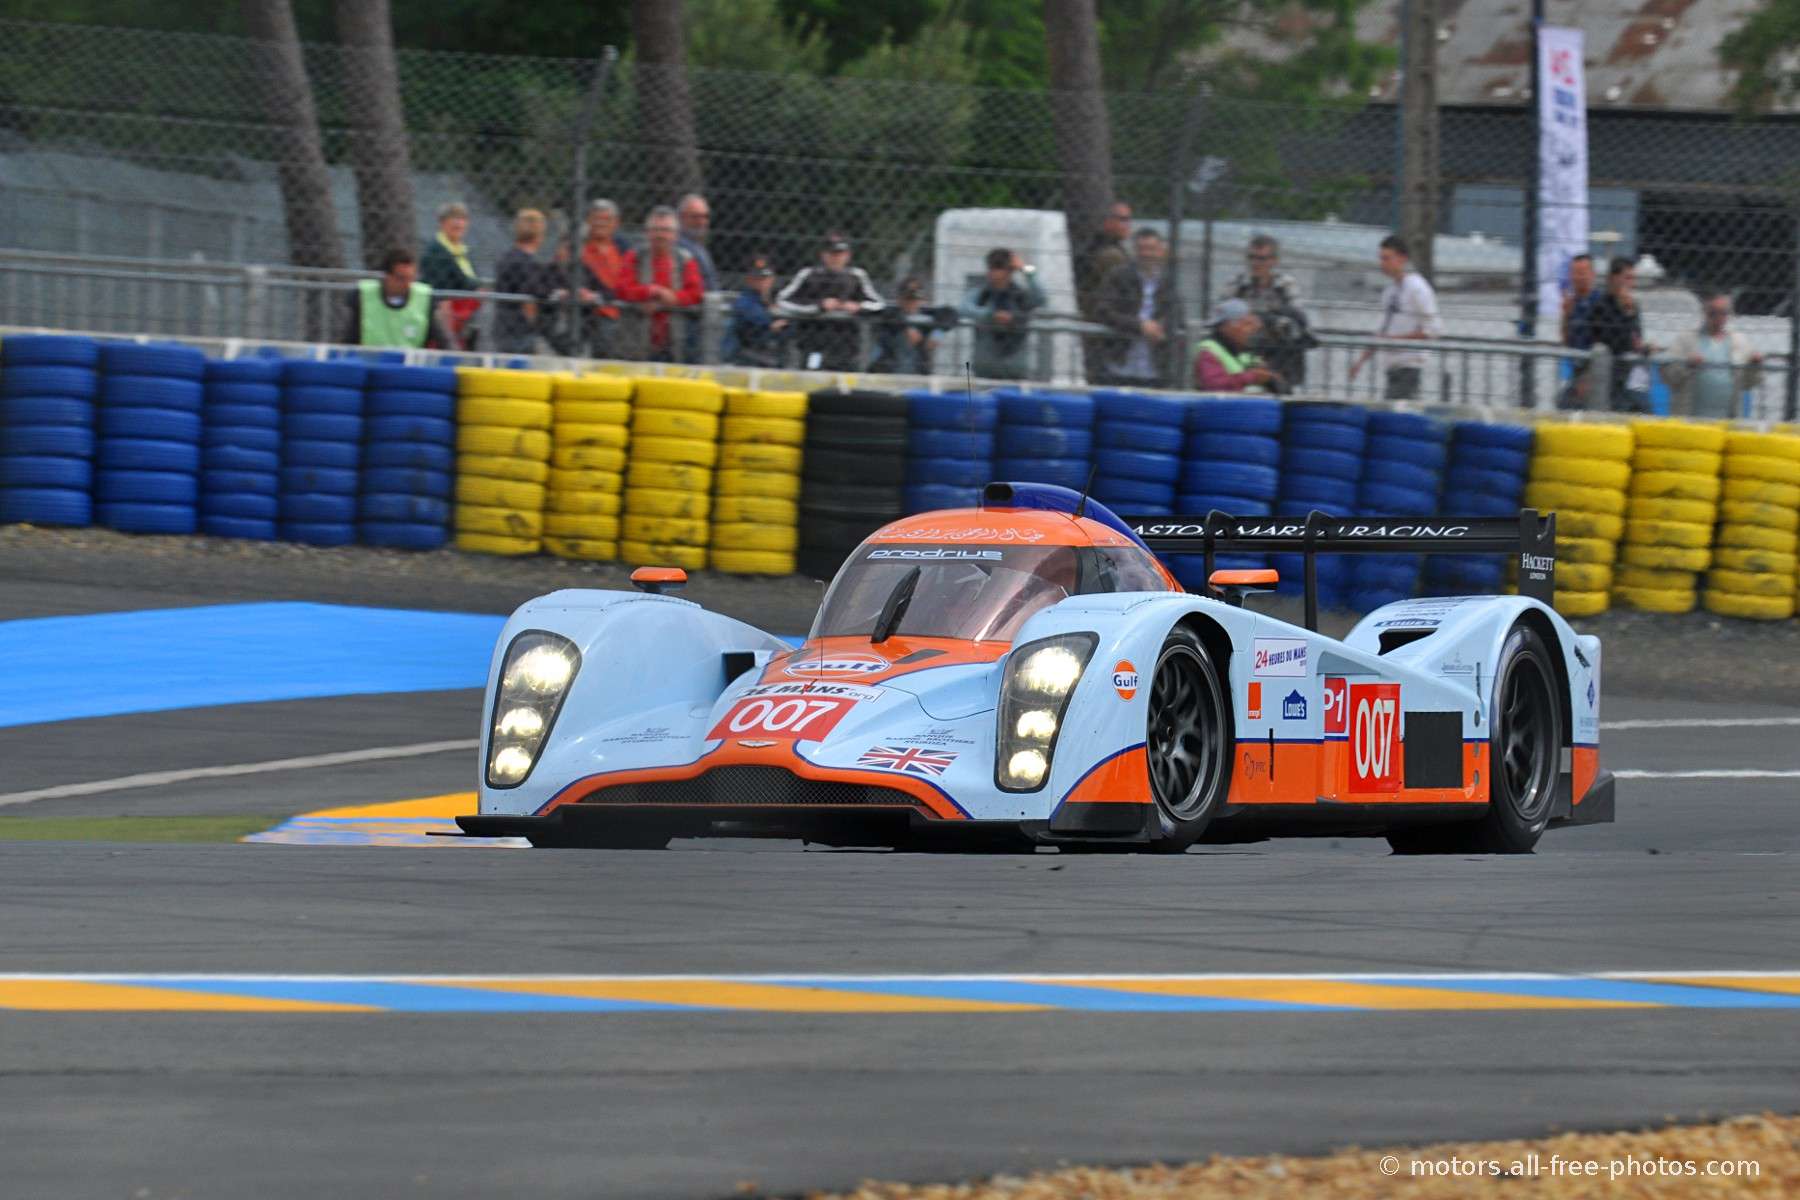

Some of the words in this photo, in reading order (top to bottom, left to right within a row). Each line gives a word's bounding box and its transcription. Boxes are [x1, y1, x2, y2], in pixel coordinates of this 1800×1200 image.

[1232, 525, 1345, 537] MAR
[1348, 525, 1469, 537] RACING
[866, 549, 1002, 561] prodrive
[1522, 552, 1554, 571] HACKETT
[790, 663, 887, 672] Gulf
[1255, 650, 1268, 669] 24
[1113, 674, 1138, 687] Gulf
[729, 699, 840, 732] 007
[1354, 698, 1396, 779] 007
